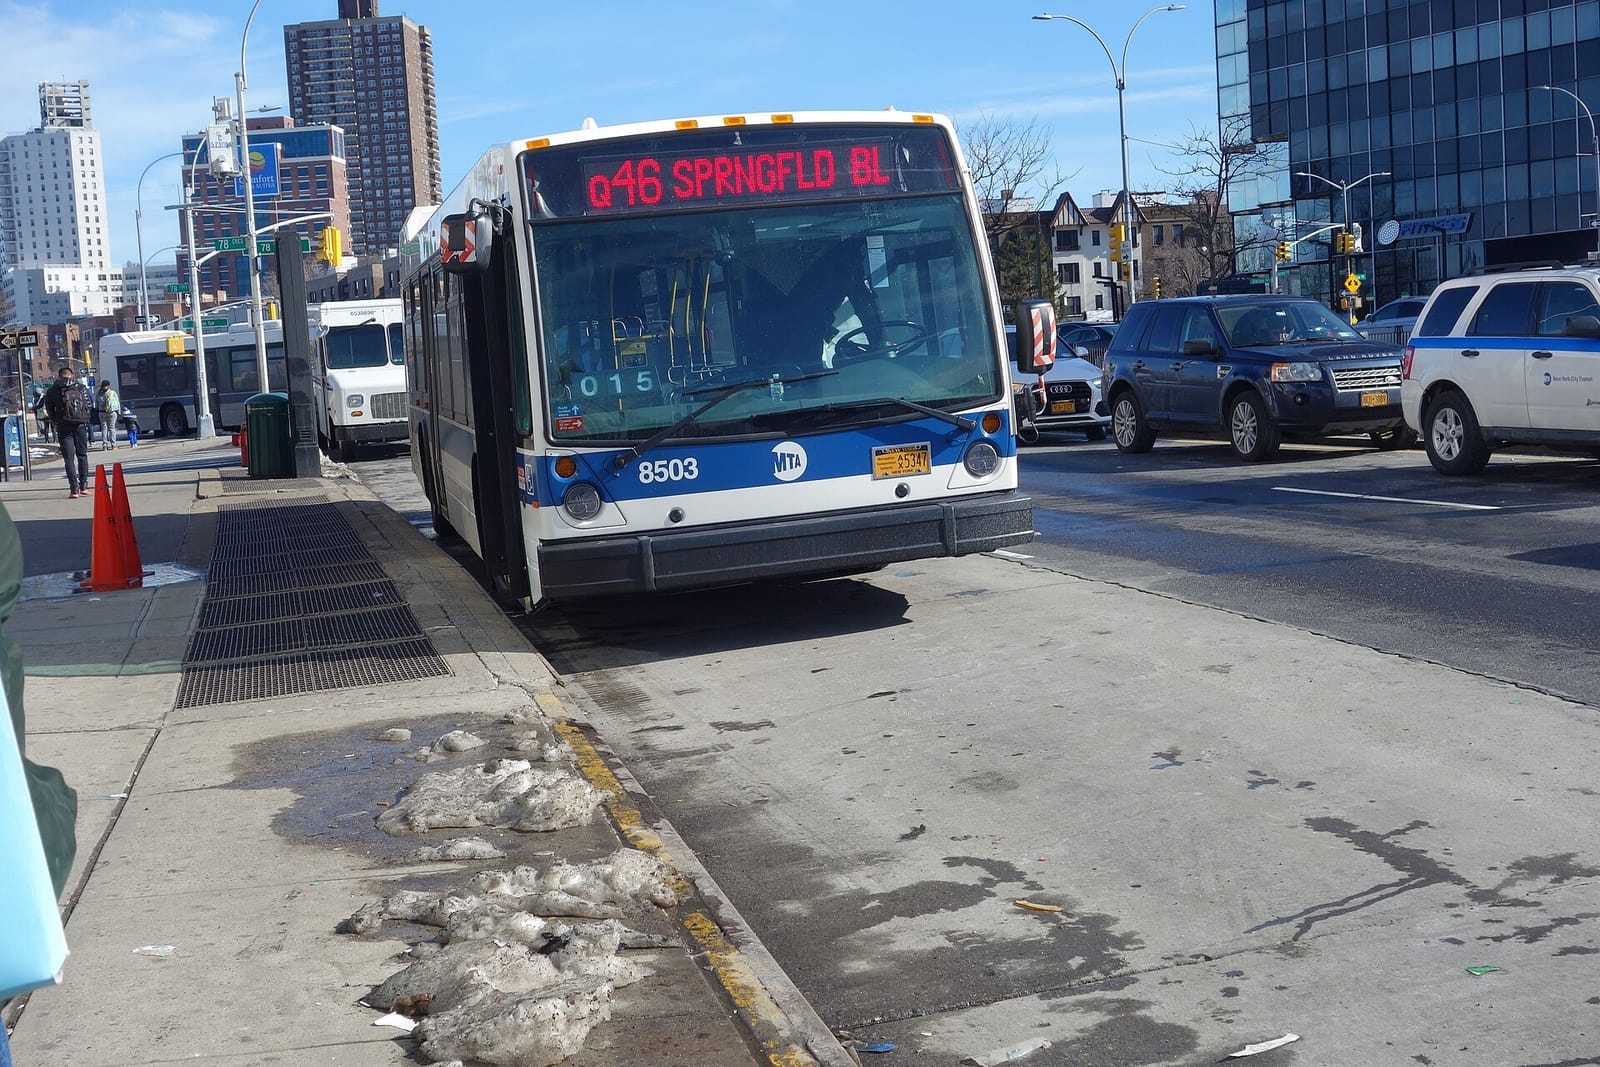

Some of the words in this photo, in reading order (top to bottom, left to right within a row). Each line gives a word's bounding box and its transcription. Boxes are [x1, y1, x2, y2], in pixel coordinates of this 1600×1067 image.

[588, 158, 663, 208] Q46
[672, 149, 835, 199] SPRNGFLD
[851, 146, 890, 186] BL
[218, 239, 229, 250] 78
[260, 243, 271, 252] 78
[638, 457, 699, 484] 8503
